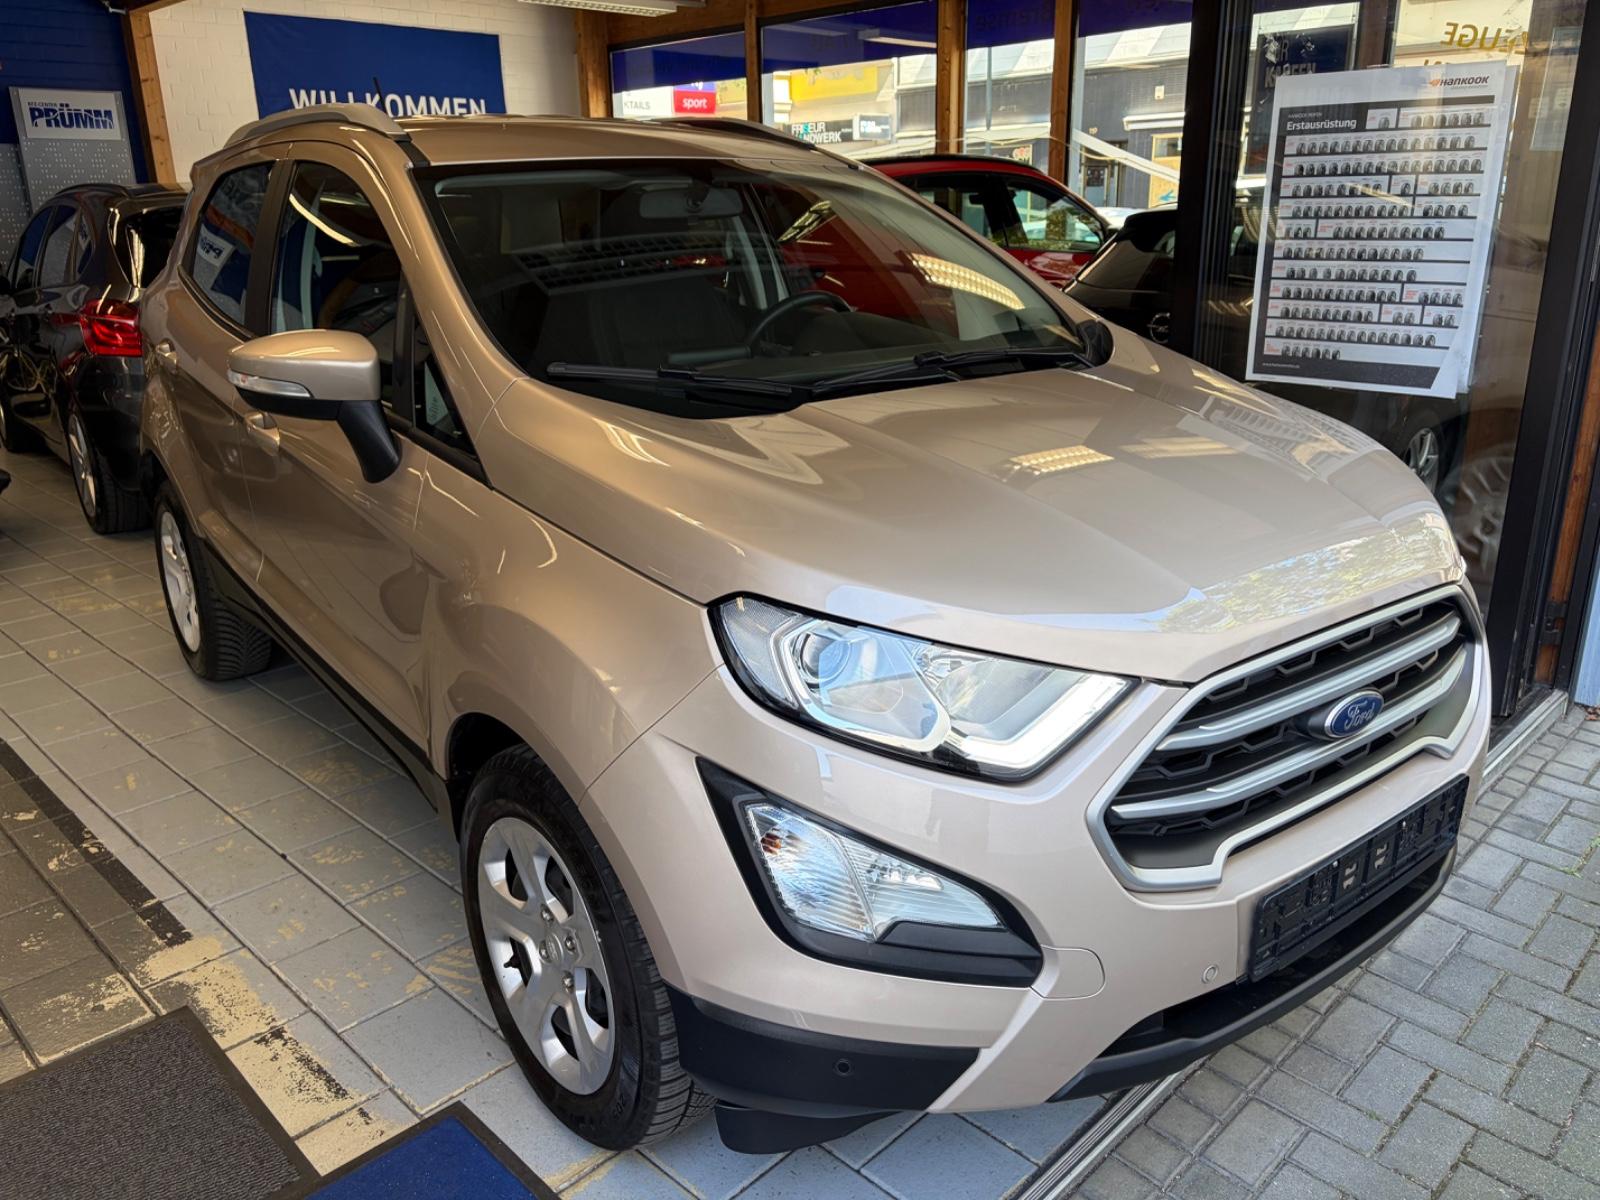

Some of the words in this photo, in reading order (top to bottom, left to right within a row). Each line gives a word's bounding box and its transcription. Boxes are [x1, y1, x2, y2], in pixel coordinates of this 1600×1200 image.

[289, 87, 487, 117] WILLKOMMEN
[681, 97, 708, 110] sport
[29, 103, 115, 129] PRÜMM
[1287, 120, 1357, 132] Erstausrüstung
[1344, 700, 1376, 730] Ford
